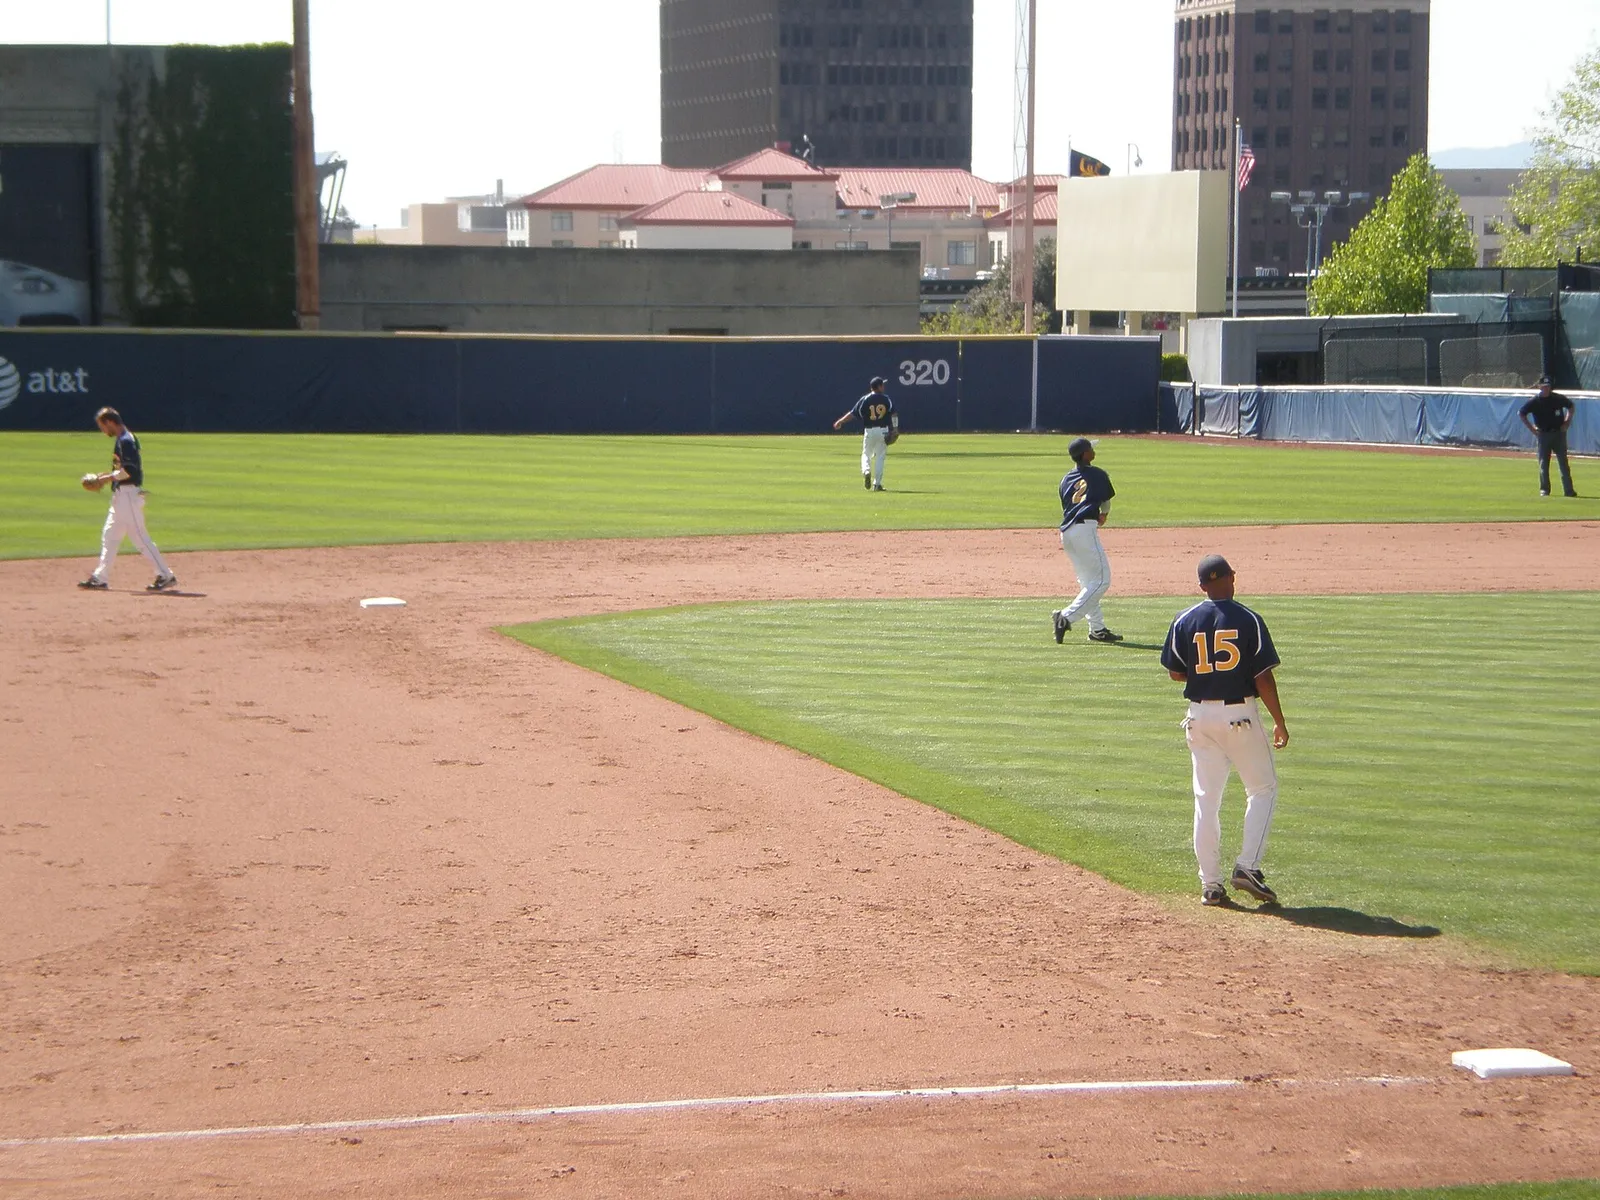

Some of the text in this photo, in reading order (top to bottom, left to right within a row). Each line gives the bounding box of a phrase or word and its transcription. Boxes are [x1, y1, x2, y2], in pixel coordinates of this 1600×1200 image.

[27, 367, 89, 393] at&t
[899, 359, 950, 385] 320
[869, 404, 886, 420] 19
[1072, 479, 1088, 504] 2
[1192, 629, 1241, 675] 15
